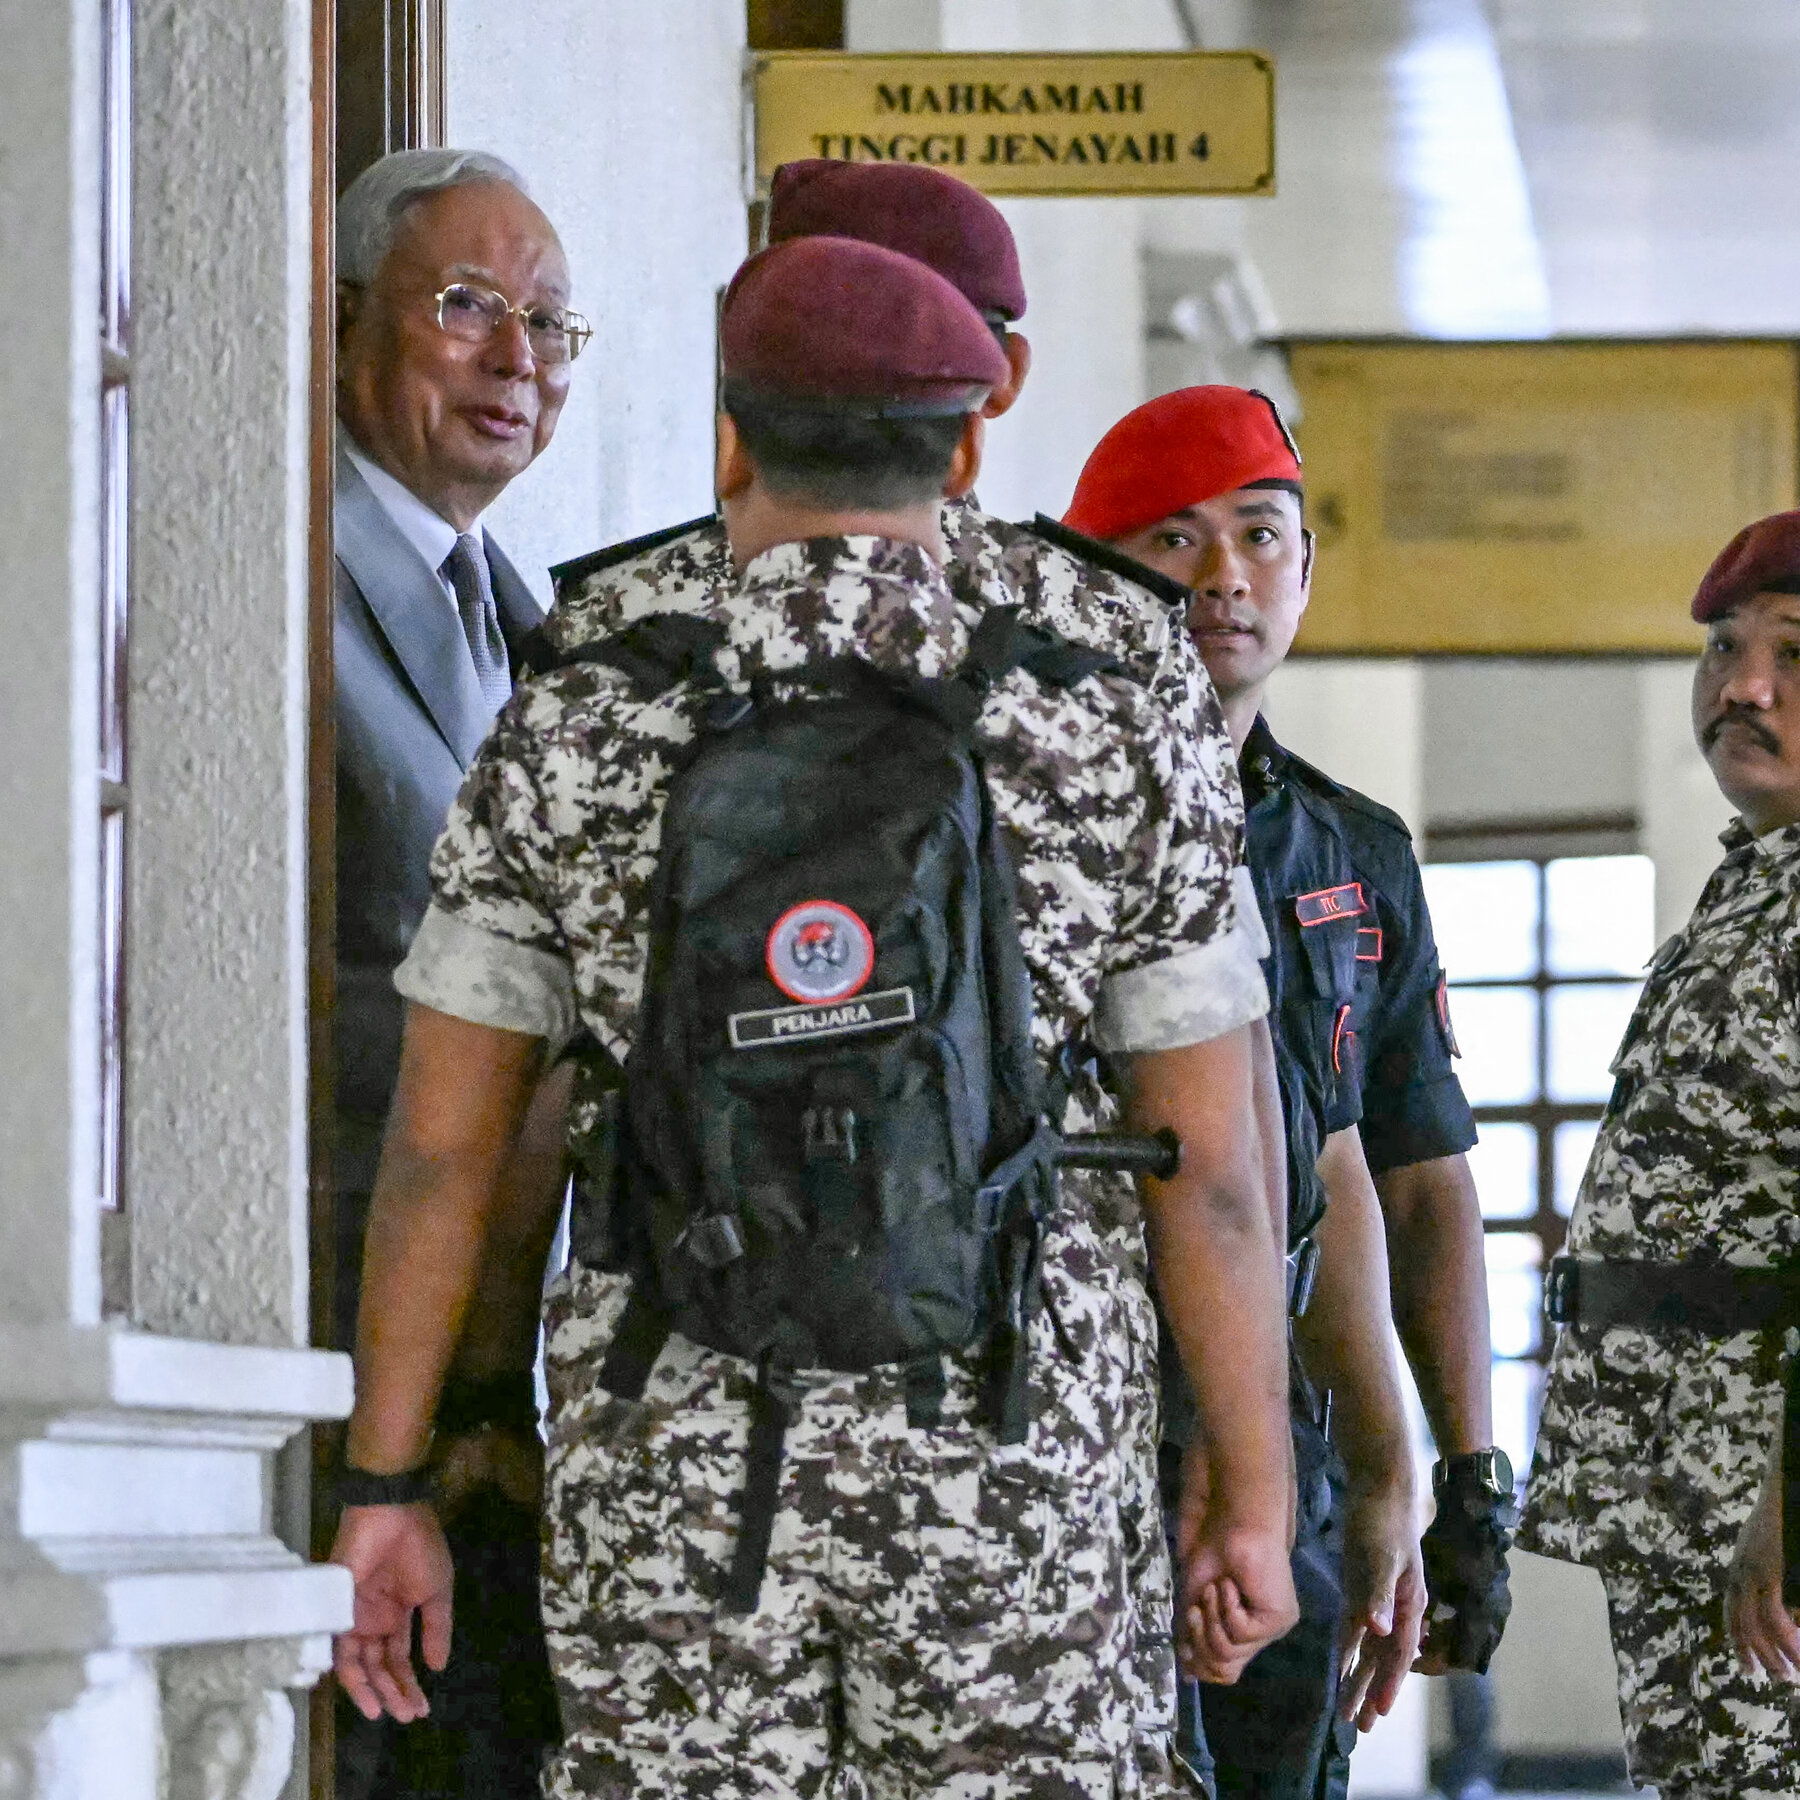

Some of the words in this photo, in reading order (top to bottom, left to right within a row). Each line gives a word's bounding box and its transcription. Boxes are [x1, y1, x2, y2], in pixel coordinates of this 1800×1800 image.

[875, 82, 1144, 114] MAHKAMAH
[813, 134, 967, 164] TINGGI
[979, 132, 1176, 165] JENAYAH
[1188, 132, 1210, 163] 4
[772, 1004, 872, 1036] PENJARA
